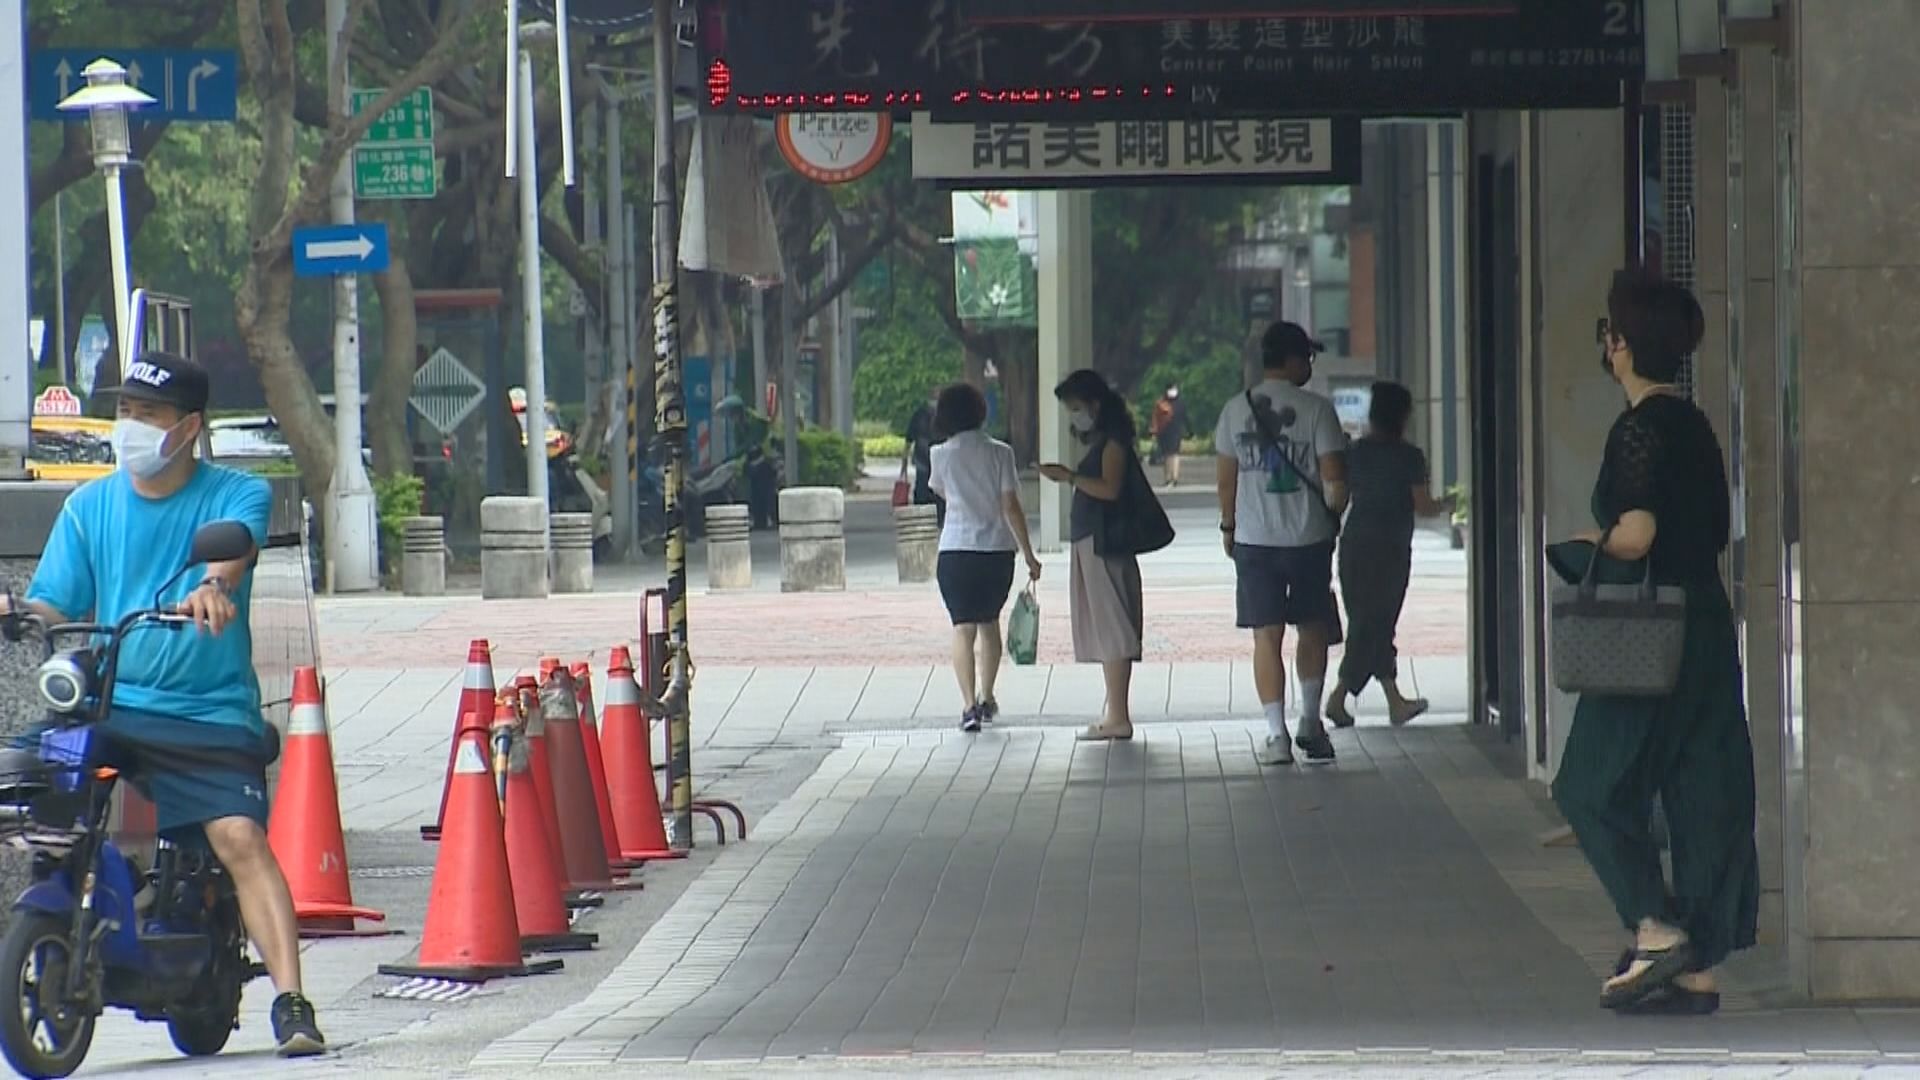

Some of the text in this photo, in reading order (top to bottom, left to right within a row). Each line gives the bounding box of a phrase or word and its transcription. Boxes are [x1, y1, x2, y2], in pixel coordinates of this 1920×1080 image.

[1160, 16, 1426, 49] 美髮造型沙龍
[1160, 54, 1423, 72] Center Point Hair Salon
[798, 111, 870, 132] Prize
[382, 164, 408, 183] 236
